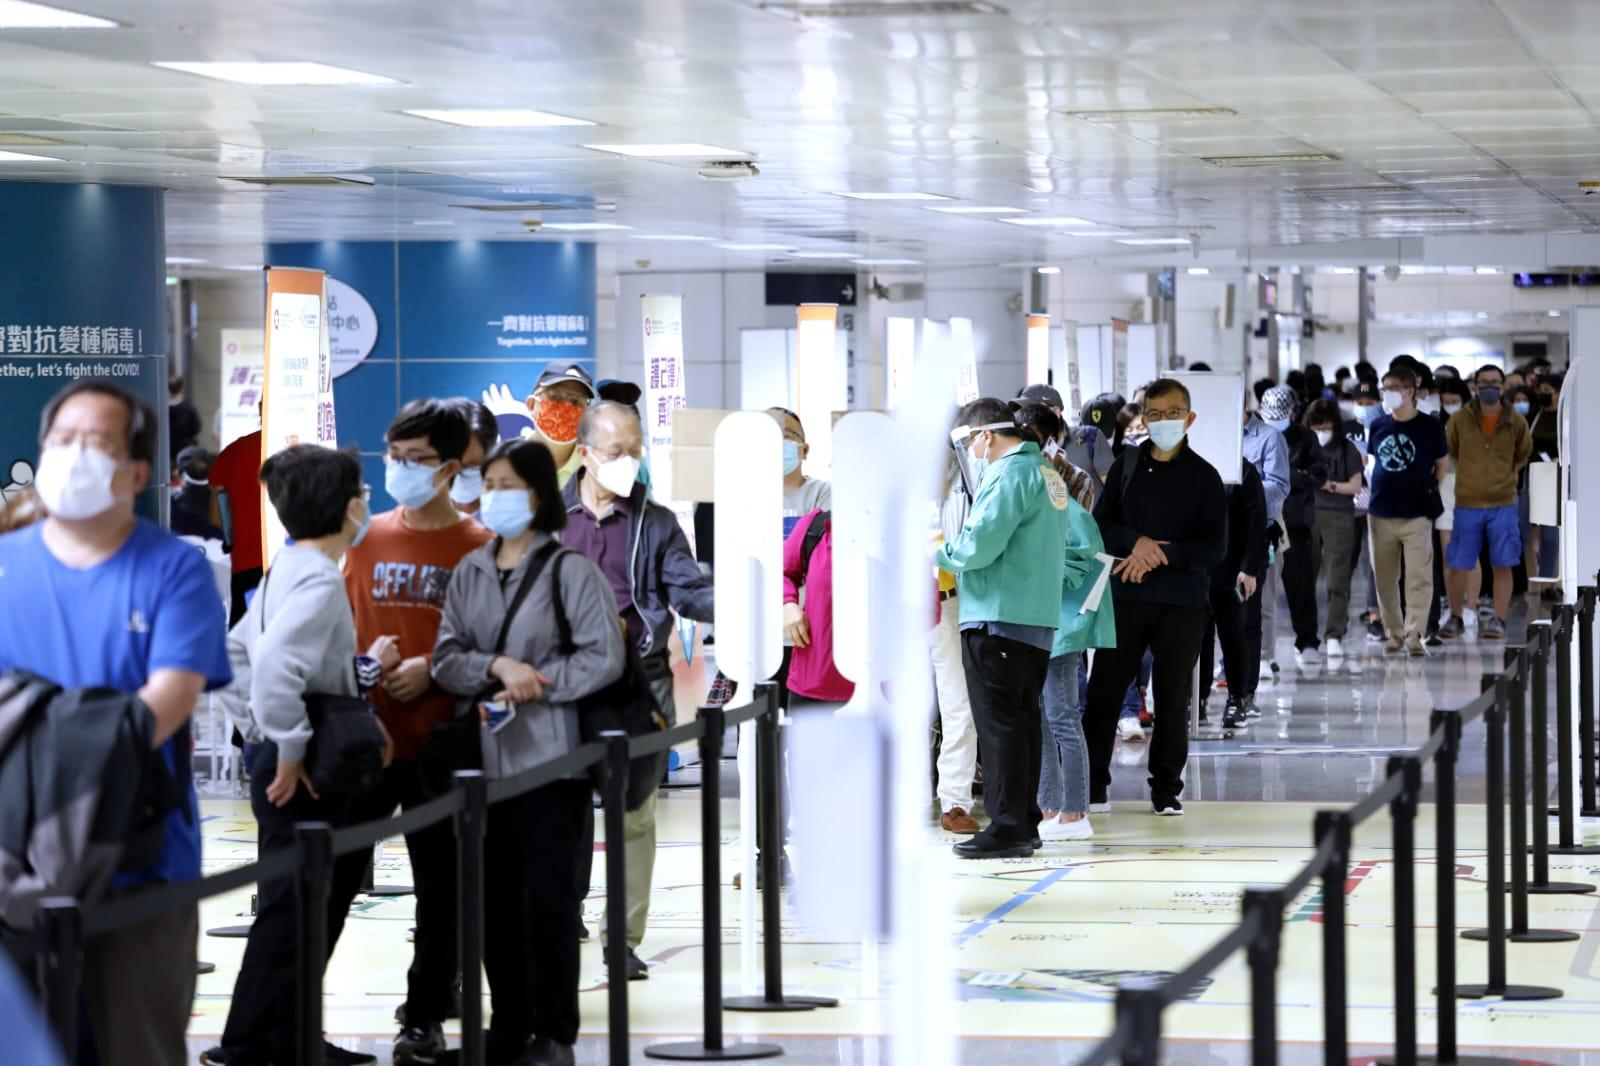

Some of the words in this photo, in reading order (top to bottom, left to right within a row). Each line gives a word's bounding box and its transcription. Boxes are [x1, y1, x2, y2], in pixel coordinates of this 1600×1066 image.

[0, 325, 142, 353] 對抗變種病毒!
[37, 363, 63, 377] let's
[64, 363, 92, 380] fight
[93, 363, 111, 376] the
[111, 363, 140, 377] COVID!
